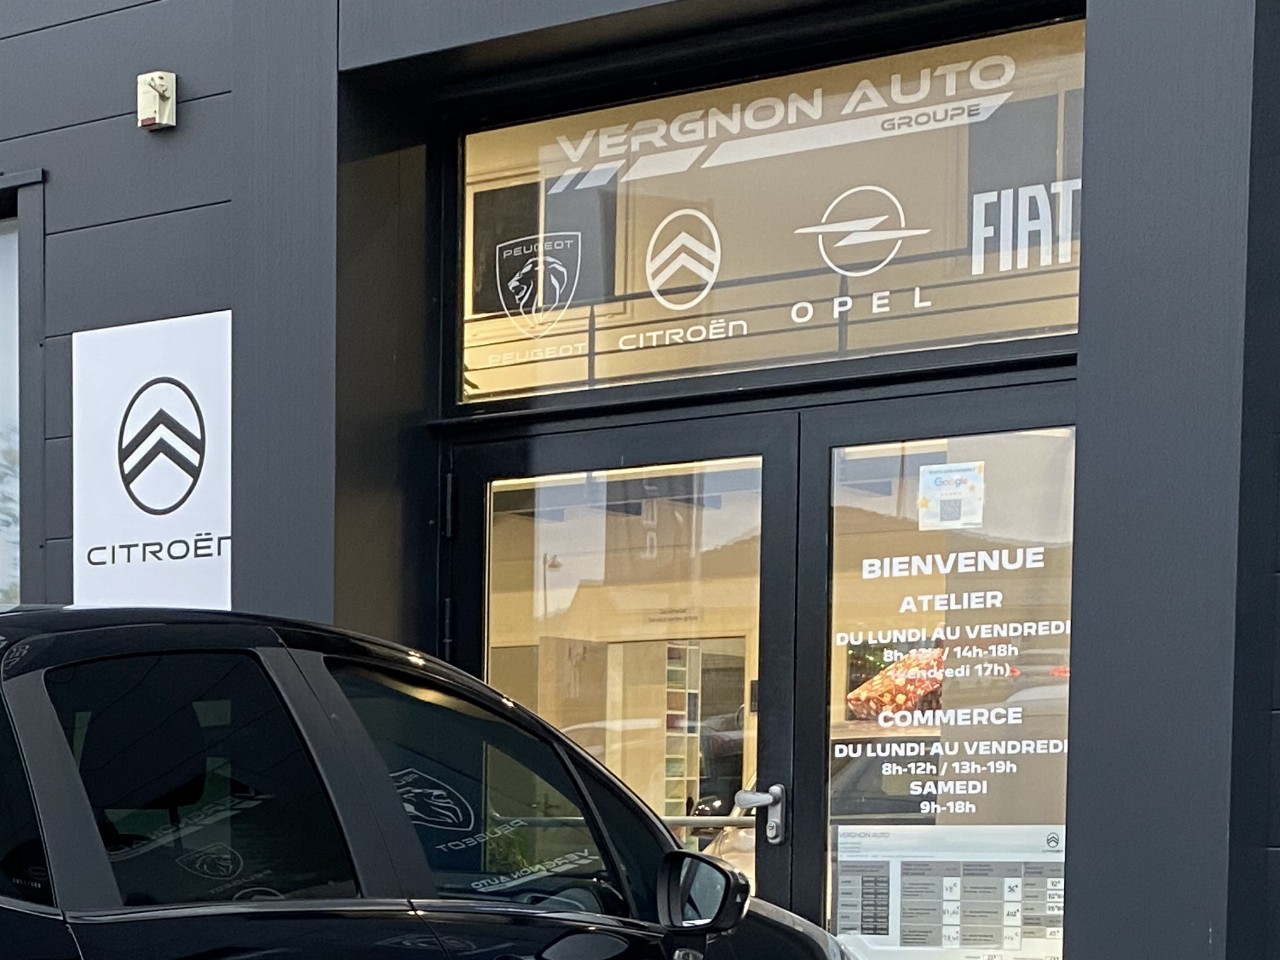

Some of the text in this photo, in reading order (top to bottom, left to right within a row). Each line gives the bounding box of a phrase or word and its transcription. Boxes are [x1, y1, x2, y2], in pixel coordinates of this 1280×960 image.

[556, 55, 1016, 162] VERGNON AUTO
[880, 103, 982, 132] GROUPE
[971, 178, 1082, 275] FIAT
[503, 240, 574, 259] PEUGEOT
[791, 286, 932, 323] OPEL
[488, 343, 587, 364] PEUGEOT
[861, 547, 1045, 579] BIENVENUE
[899, 591, 1003, 613] ATELIER
[836, 620, 1071, 646] DU LUNDI AU VENDREDI
[953, 644, 1019, 659] 14h-18h
[974, 662, 1011, 678] 17h)
[878, 707, 1023, 728] COMMERCE
[834, 739, 1068, 758] DU LUNDI AU VENDREDI
[881, 761, 937, 775] 8h-12h
[951, 760, 1017, 774] 13h-19h
[909, 780, 988, 796] SAMEDI
[920, 800, 976, 814] 9h-18h
